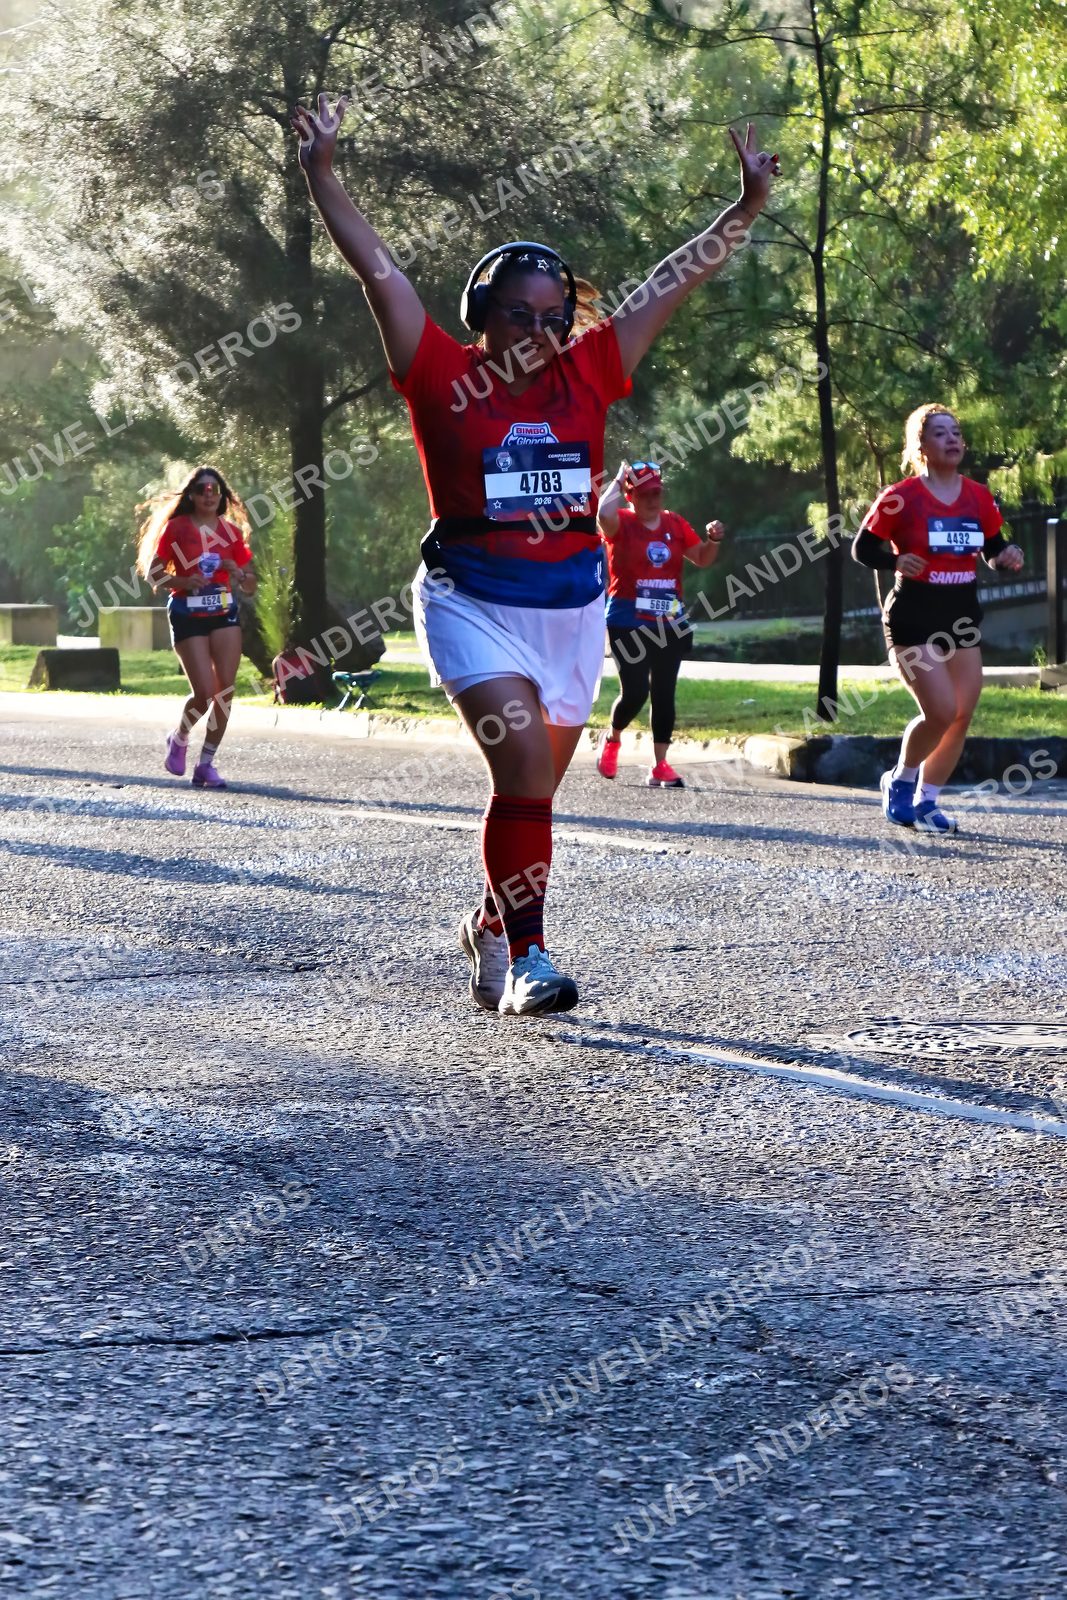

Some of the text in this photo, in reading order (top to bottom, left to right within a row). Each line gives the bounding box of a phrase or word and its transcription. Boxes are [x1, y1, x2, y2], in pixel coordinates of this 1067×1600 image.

[516, 427, 546, 435] BIMBO
[520, 471, 562, 494] 4783
[947, 532, 970, 545] 4432
[201, 594, 221, 606] 4524
[650, 599, 670, 611] 5696
